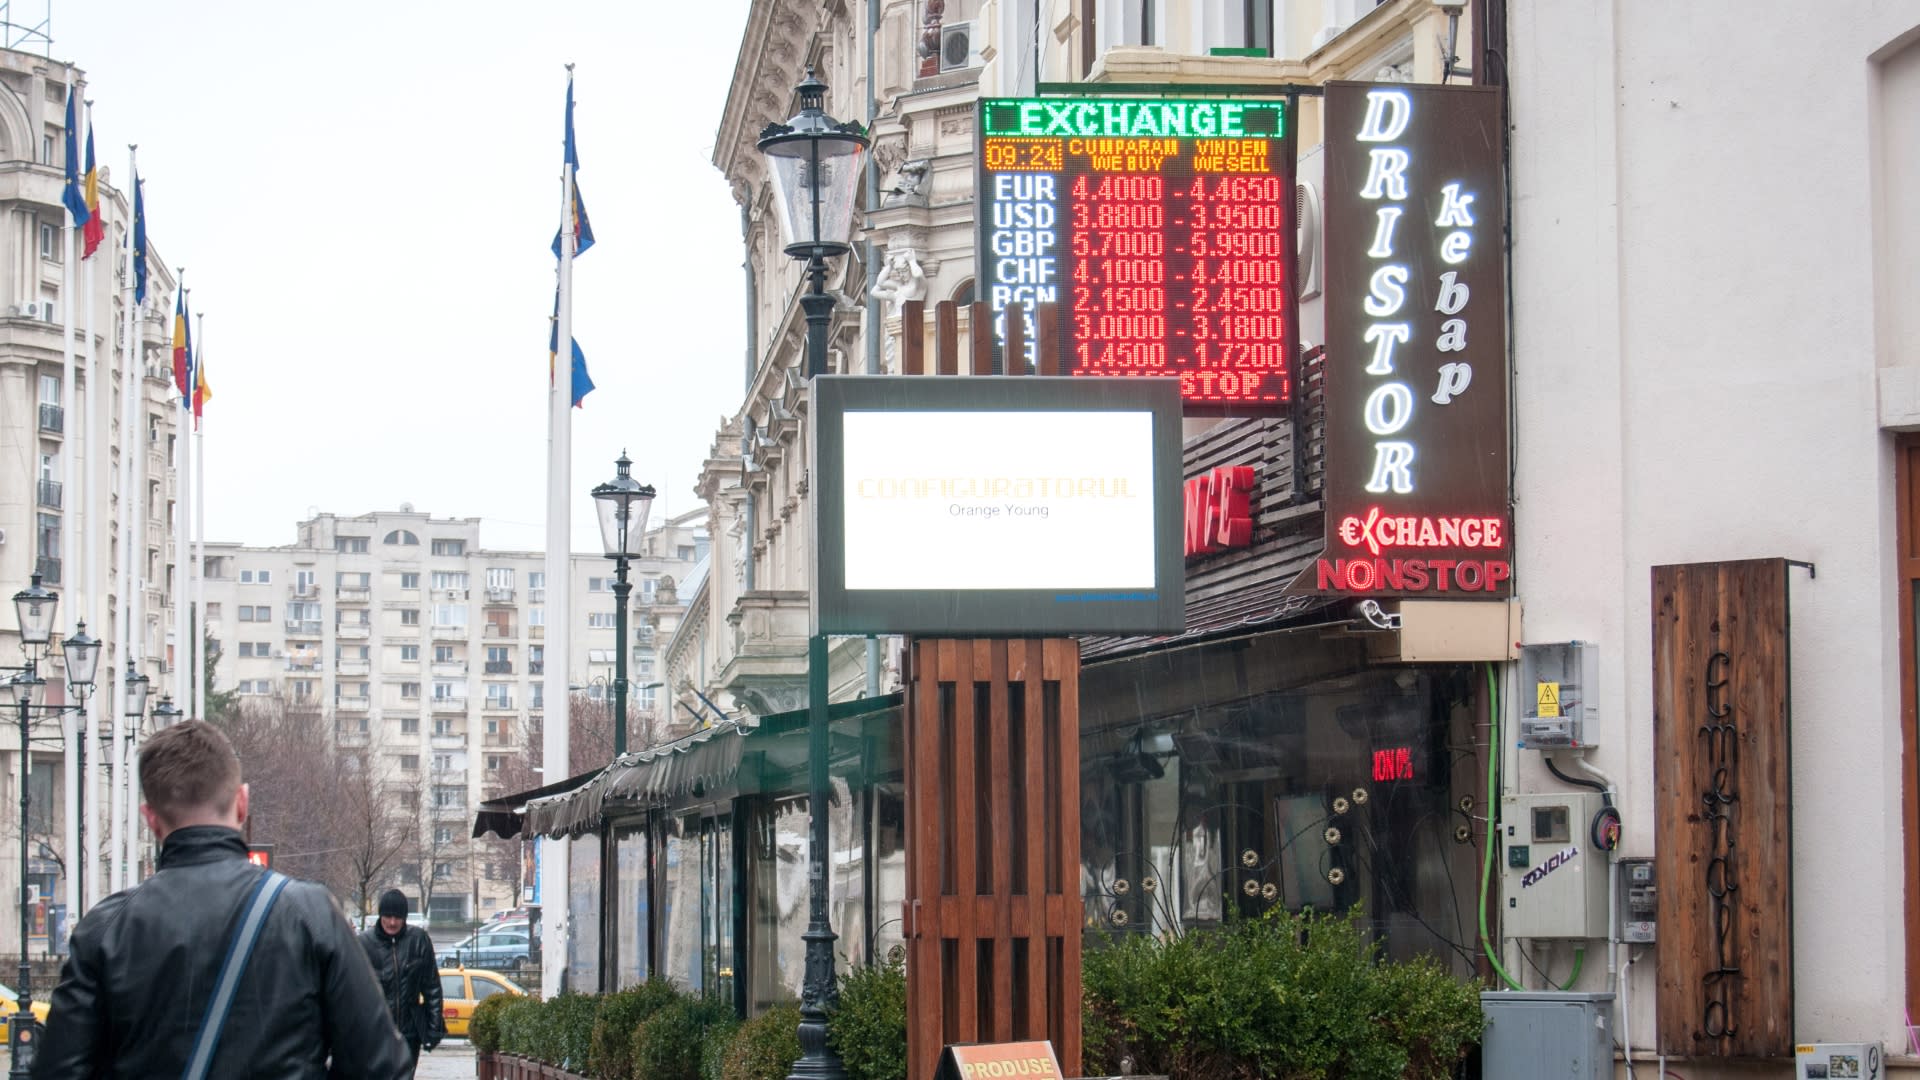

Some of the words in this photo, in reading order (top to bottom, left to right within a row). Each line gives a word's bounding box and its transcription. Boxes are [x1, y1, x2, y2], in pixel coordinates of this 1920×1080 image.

[1021, 103, 1243, 136] EXCHANGE
[990, 145, 1057, 166] 09:24
[1069, 139, 1178, 155] CUMPARAM
[1196, 139, 1268, 156] VINDEM
[996, 174, 1056, 200] EUR
[1072, 176, 1162, 200] 4.4000
[1190, 177, 1281, 201] 4.4650
[993, 203, 1055, 228] USD
[1072, 204, 1163, 228] 3.8800
[1190, 205, 1281, 229] 3.9500
[992, 231, 1055, 257] GBP
[1072, 232, 1163, 256] 5.7000
[1191, 232, 1281, 257] 5.9900
[997, 258, 1056, 283] CHF
[1073, 259, 1164, 283] 4.1000
[1191, 260, 1282, 284] 4.4000
[992, 285, 1056, 311] BGN
[1073, 287, 1164, 312] 2.1500
[1192, 287, 1282, 312] 2.4500
[1356, 91, 1414, 494] DRISTOR
[1432, 183, 1475, 404] kebap
[1074, 315, 1165, 339] 3.0000
[1192, 315, 1282, 340] 3.1800
[1076, 343, 1165, 367] 1.4500
[1194, 343, 1283, 368] 1.7200
[1180, 372, 1261, 395] STOP
[949, 503, 1000, 519] Orange
[1004, 503, 1049, 519] Young
[1317, 558, 1510, 592] NONSTOP
[963, 1058, 1054, 1079] PRODUSE
